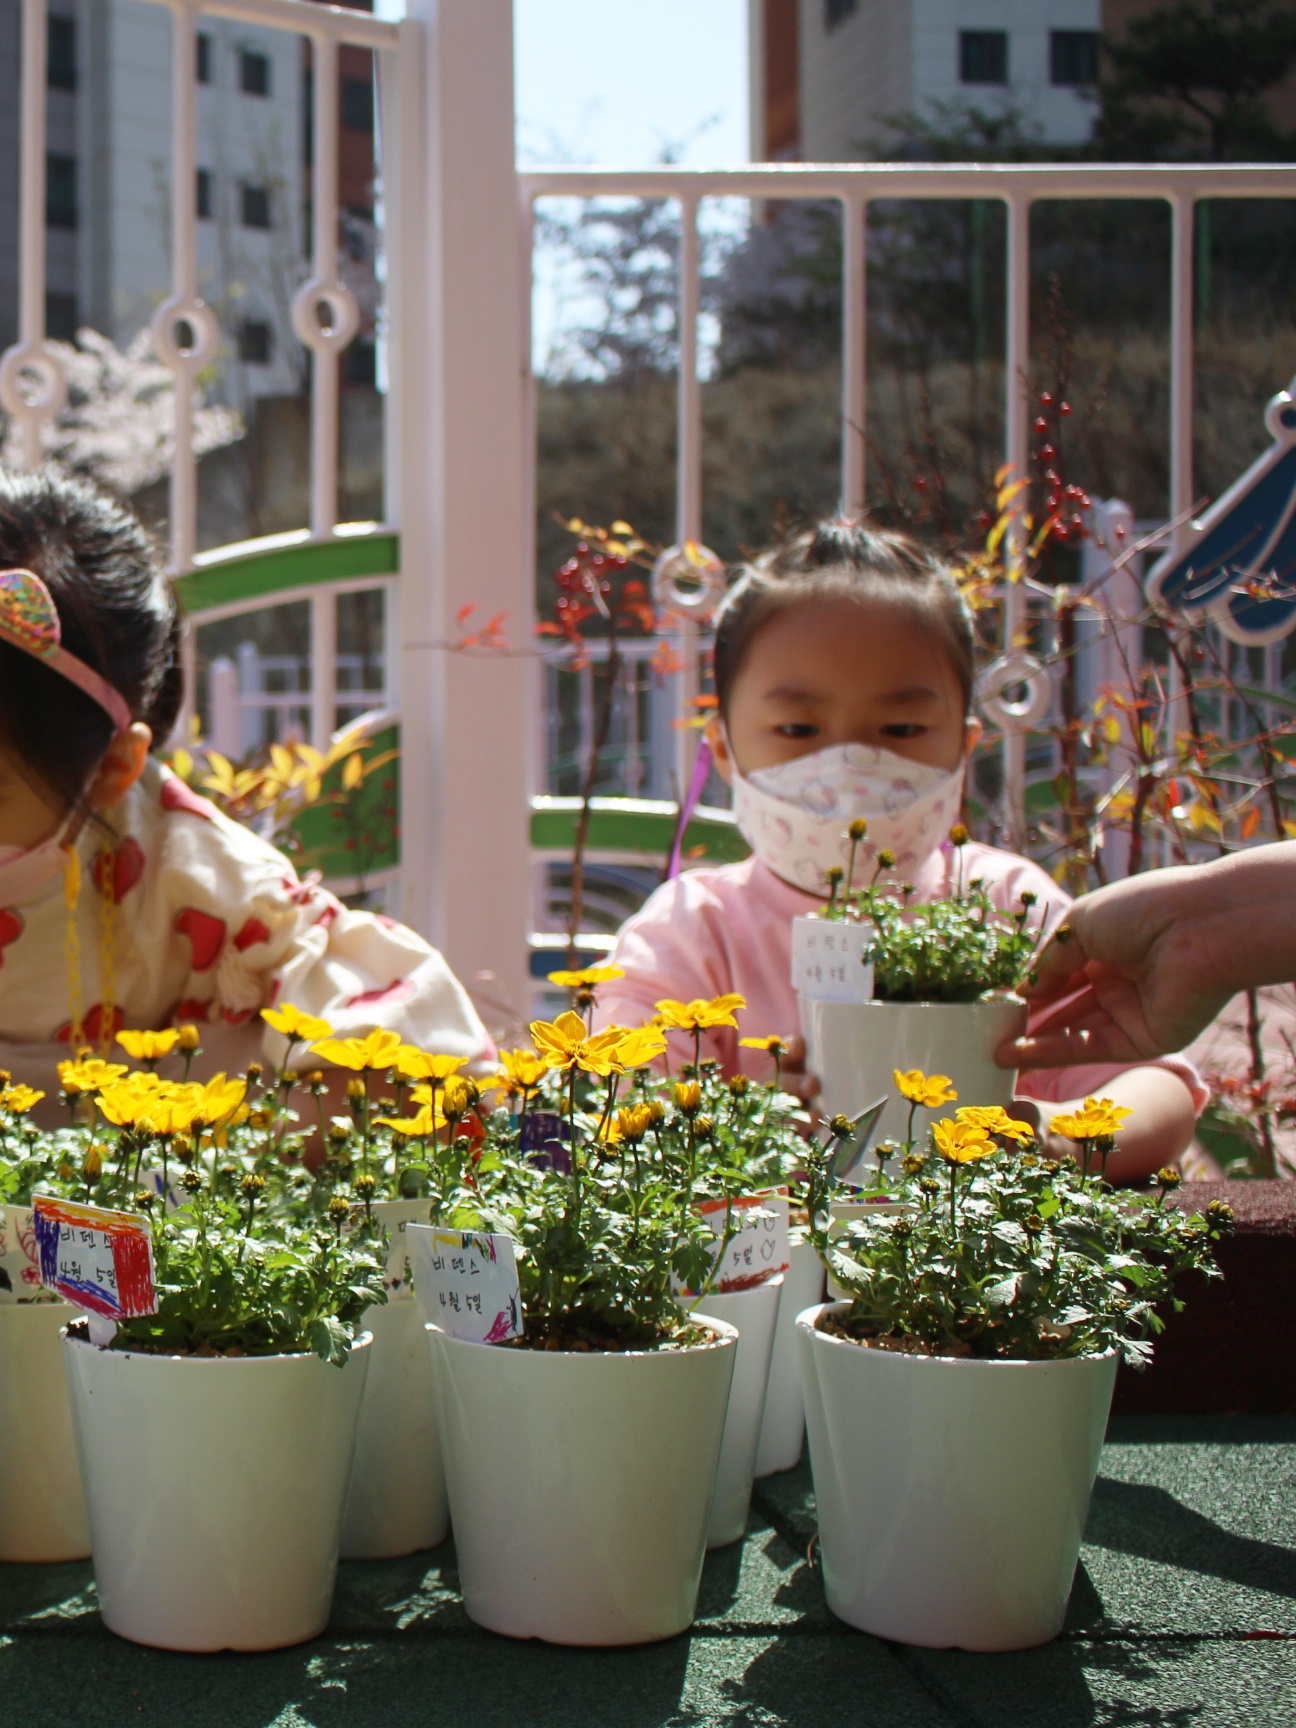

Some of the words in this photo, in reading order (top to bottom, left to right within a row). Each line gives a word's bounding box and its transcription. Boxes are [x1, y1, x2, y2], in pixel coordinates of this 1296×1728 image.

[432, 1256, 481, 1276] 비덴스
[439, 1292, 461, 1313] 4월
[465, 1292, 483, 1315] 5일
